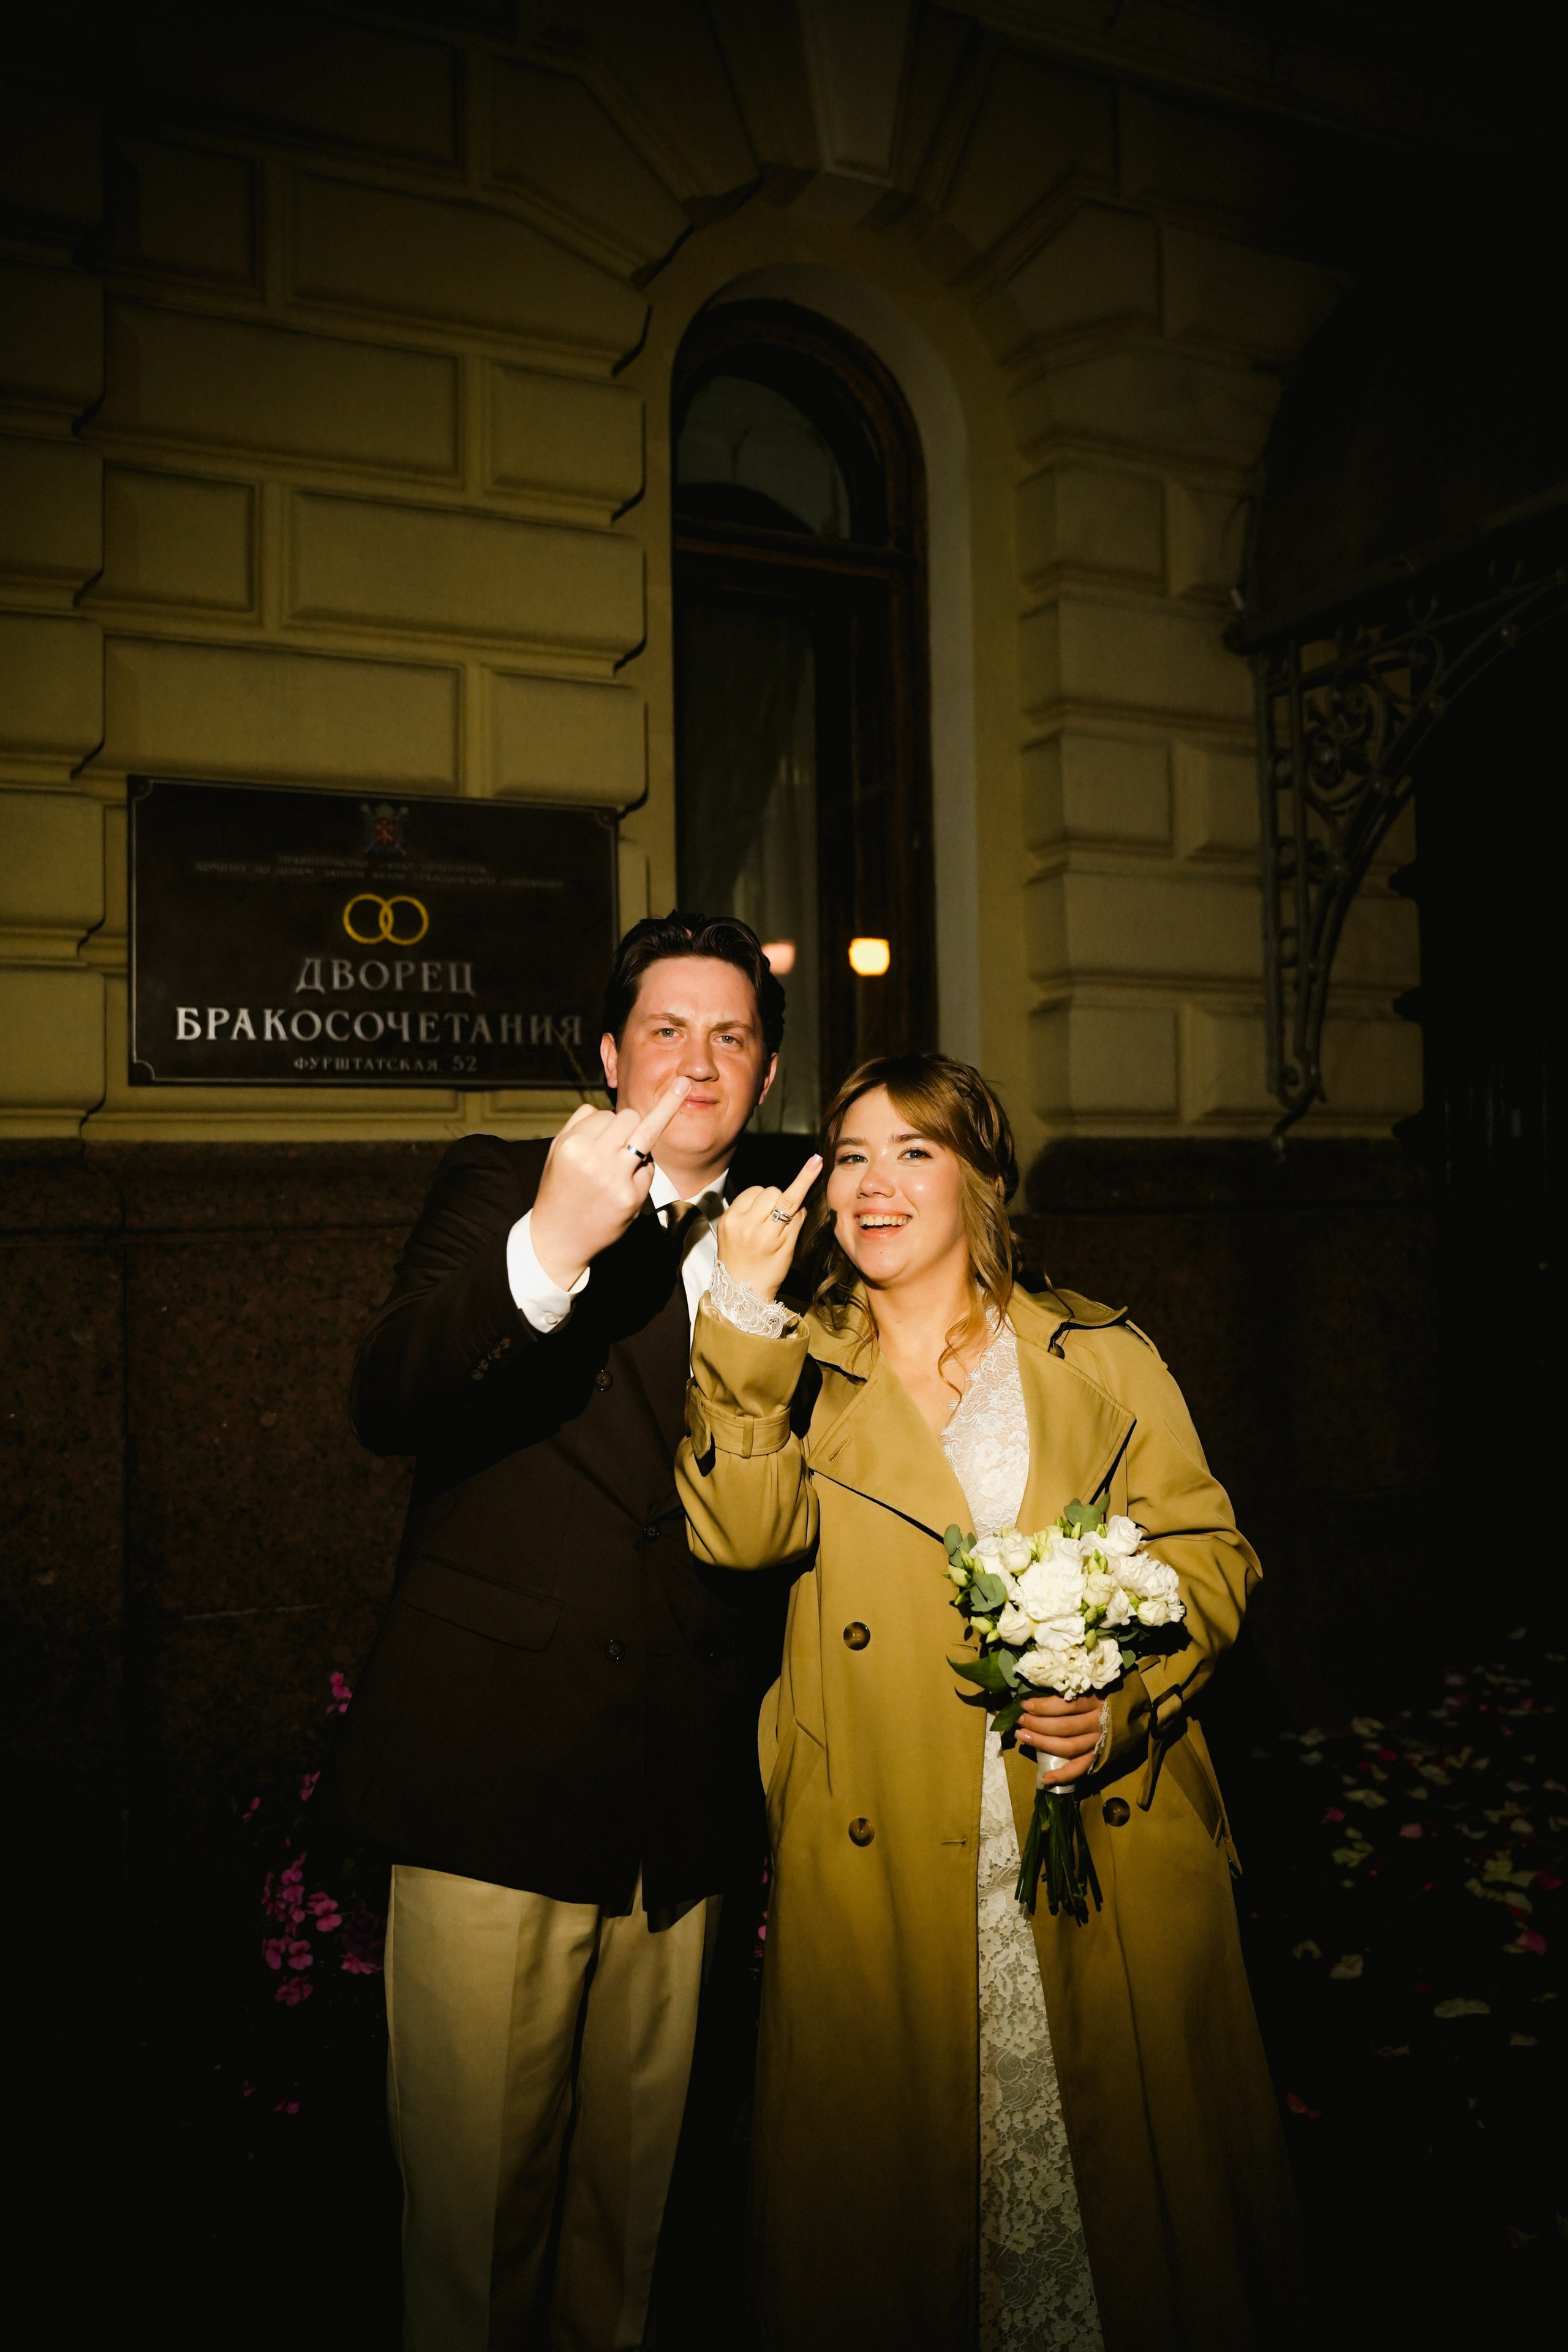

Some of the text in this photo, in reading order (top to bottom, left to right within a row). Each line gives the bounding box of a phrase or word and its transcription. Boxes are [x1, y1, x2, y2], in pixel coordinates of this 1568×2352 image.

[295, 957, 475, 997] ДВОРЕЦ
[175, 1006, 582, 1046] БРАКОСОЧЕТАНИЯ
[452, 1055, 478, 1072] 52
